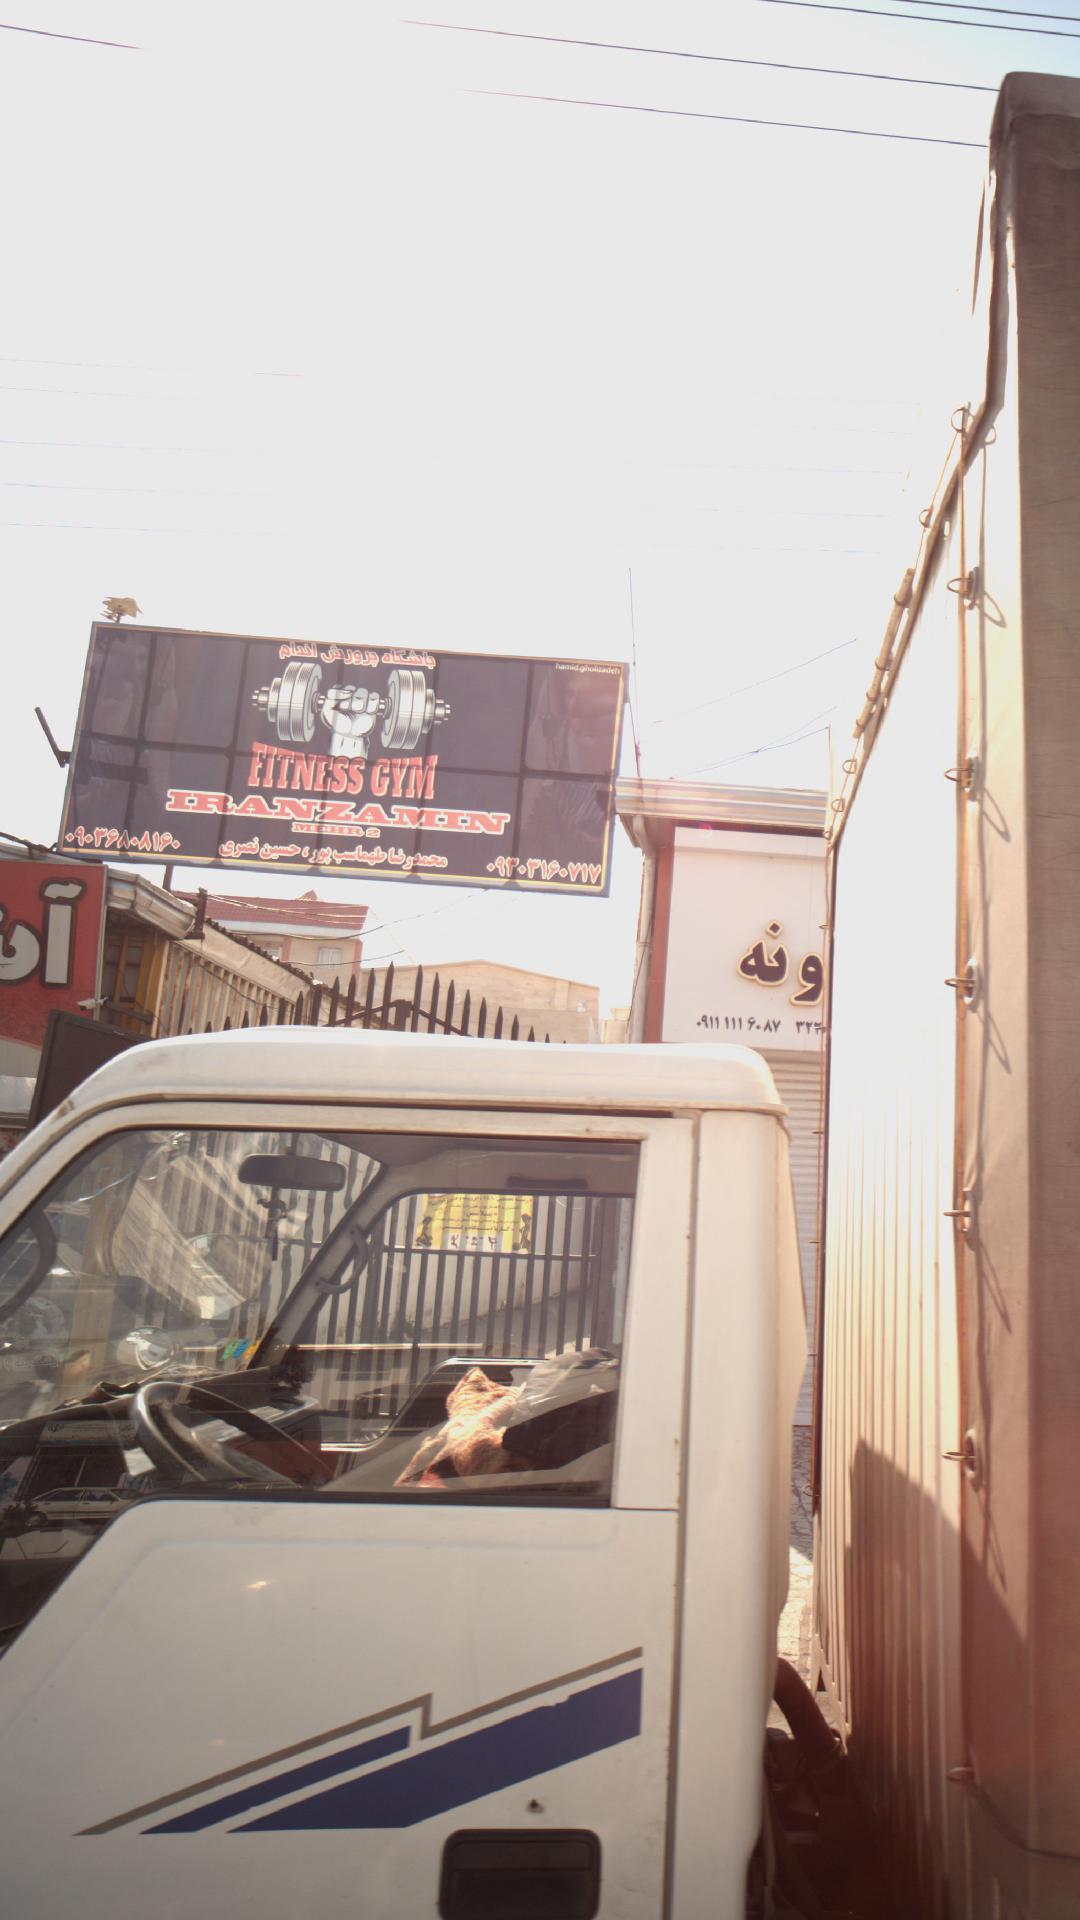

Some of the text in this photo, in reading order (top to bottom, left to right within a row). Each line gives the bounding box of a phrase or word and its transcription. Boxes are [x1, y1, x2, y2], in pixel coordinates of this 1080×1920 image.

[279, 640, 318, 659] اندام
[247, 741, 439, 799] FITNESS GYM
[165, 789, 511, 835] IRANZAMIN
[291, 822, 381, 838] MEHR 2
